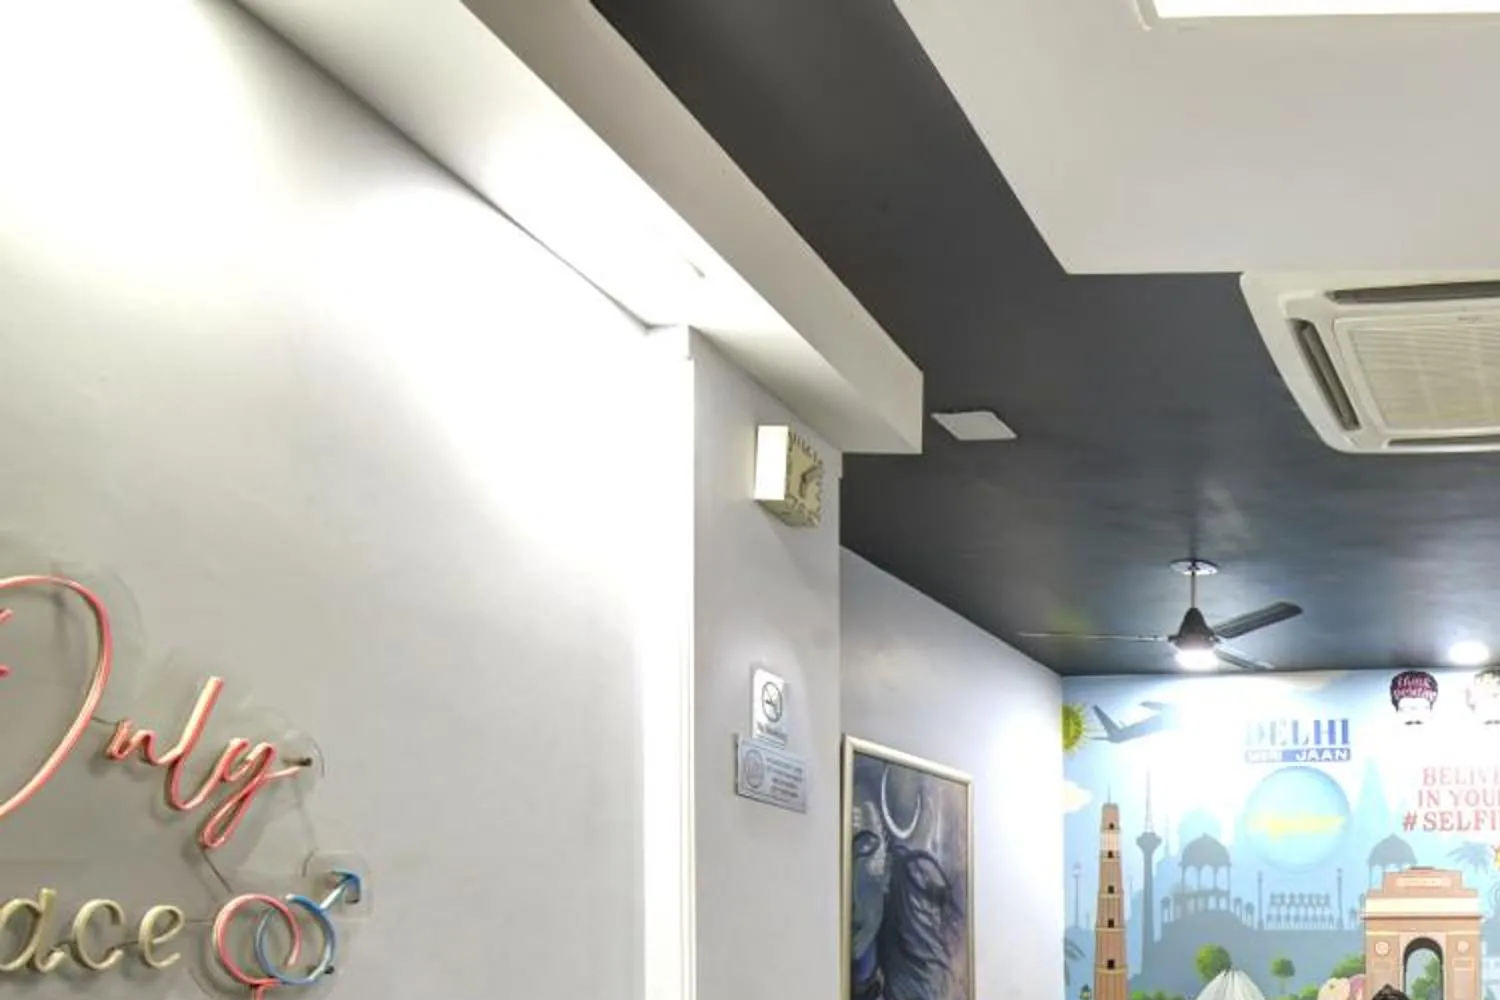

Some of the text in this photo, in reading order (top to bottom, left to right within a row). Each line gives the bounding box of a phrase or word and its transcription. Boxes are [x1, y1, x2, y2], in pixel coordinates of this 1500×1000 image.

[1245, 717, 1351, 746] DELHI
[1295, 749, 1349, 761] JAAN
[1417, 787, 1441, 808] IN
